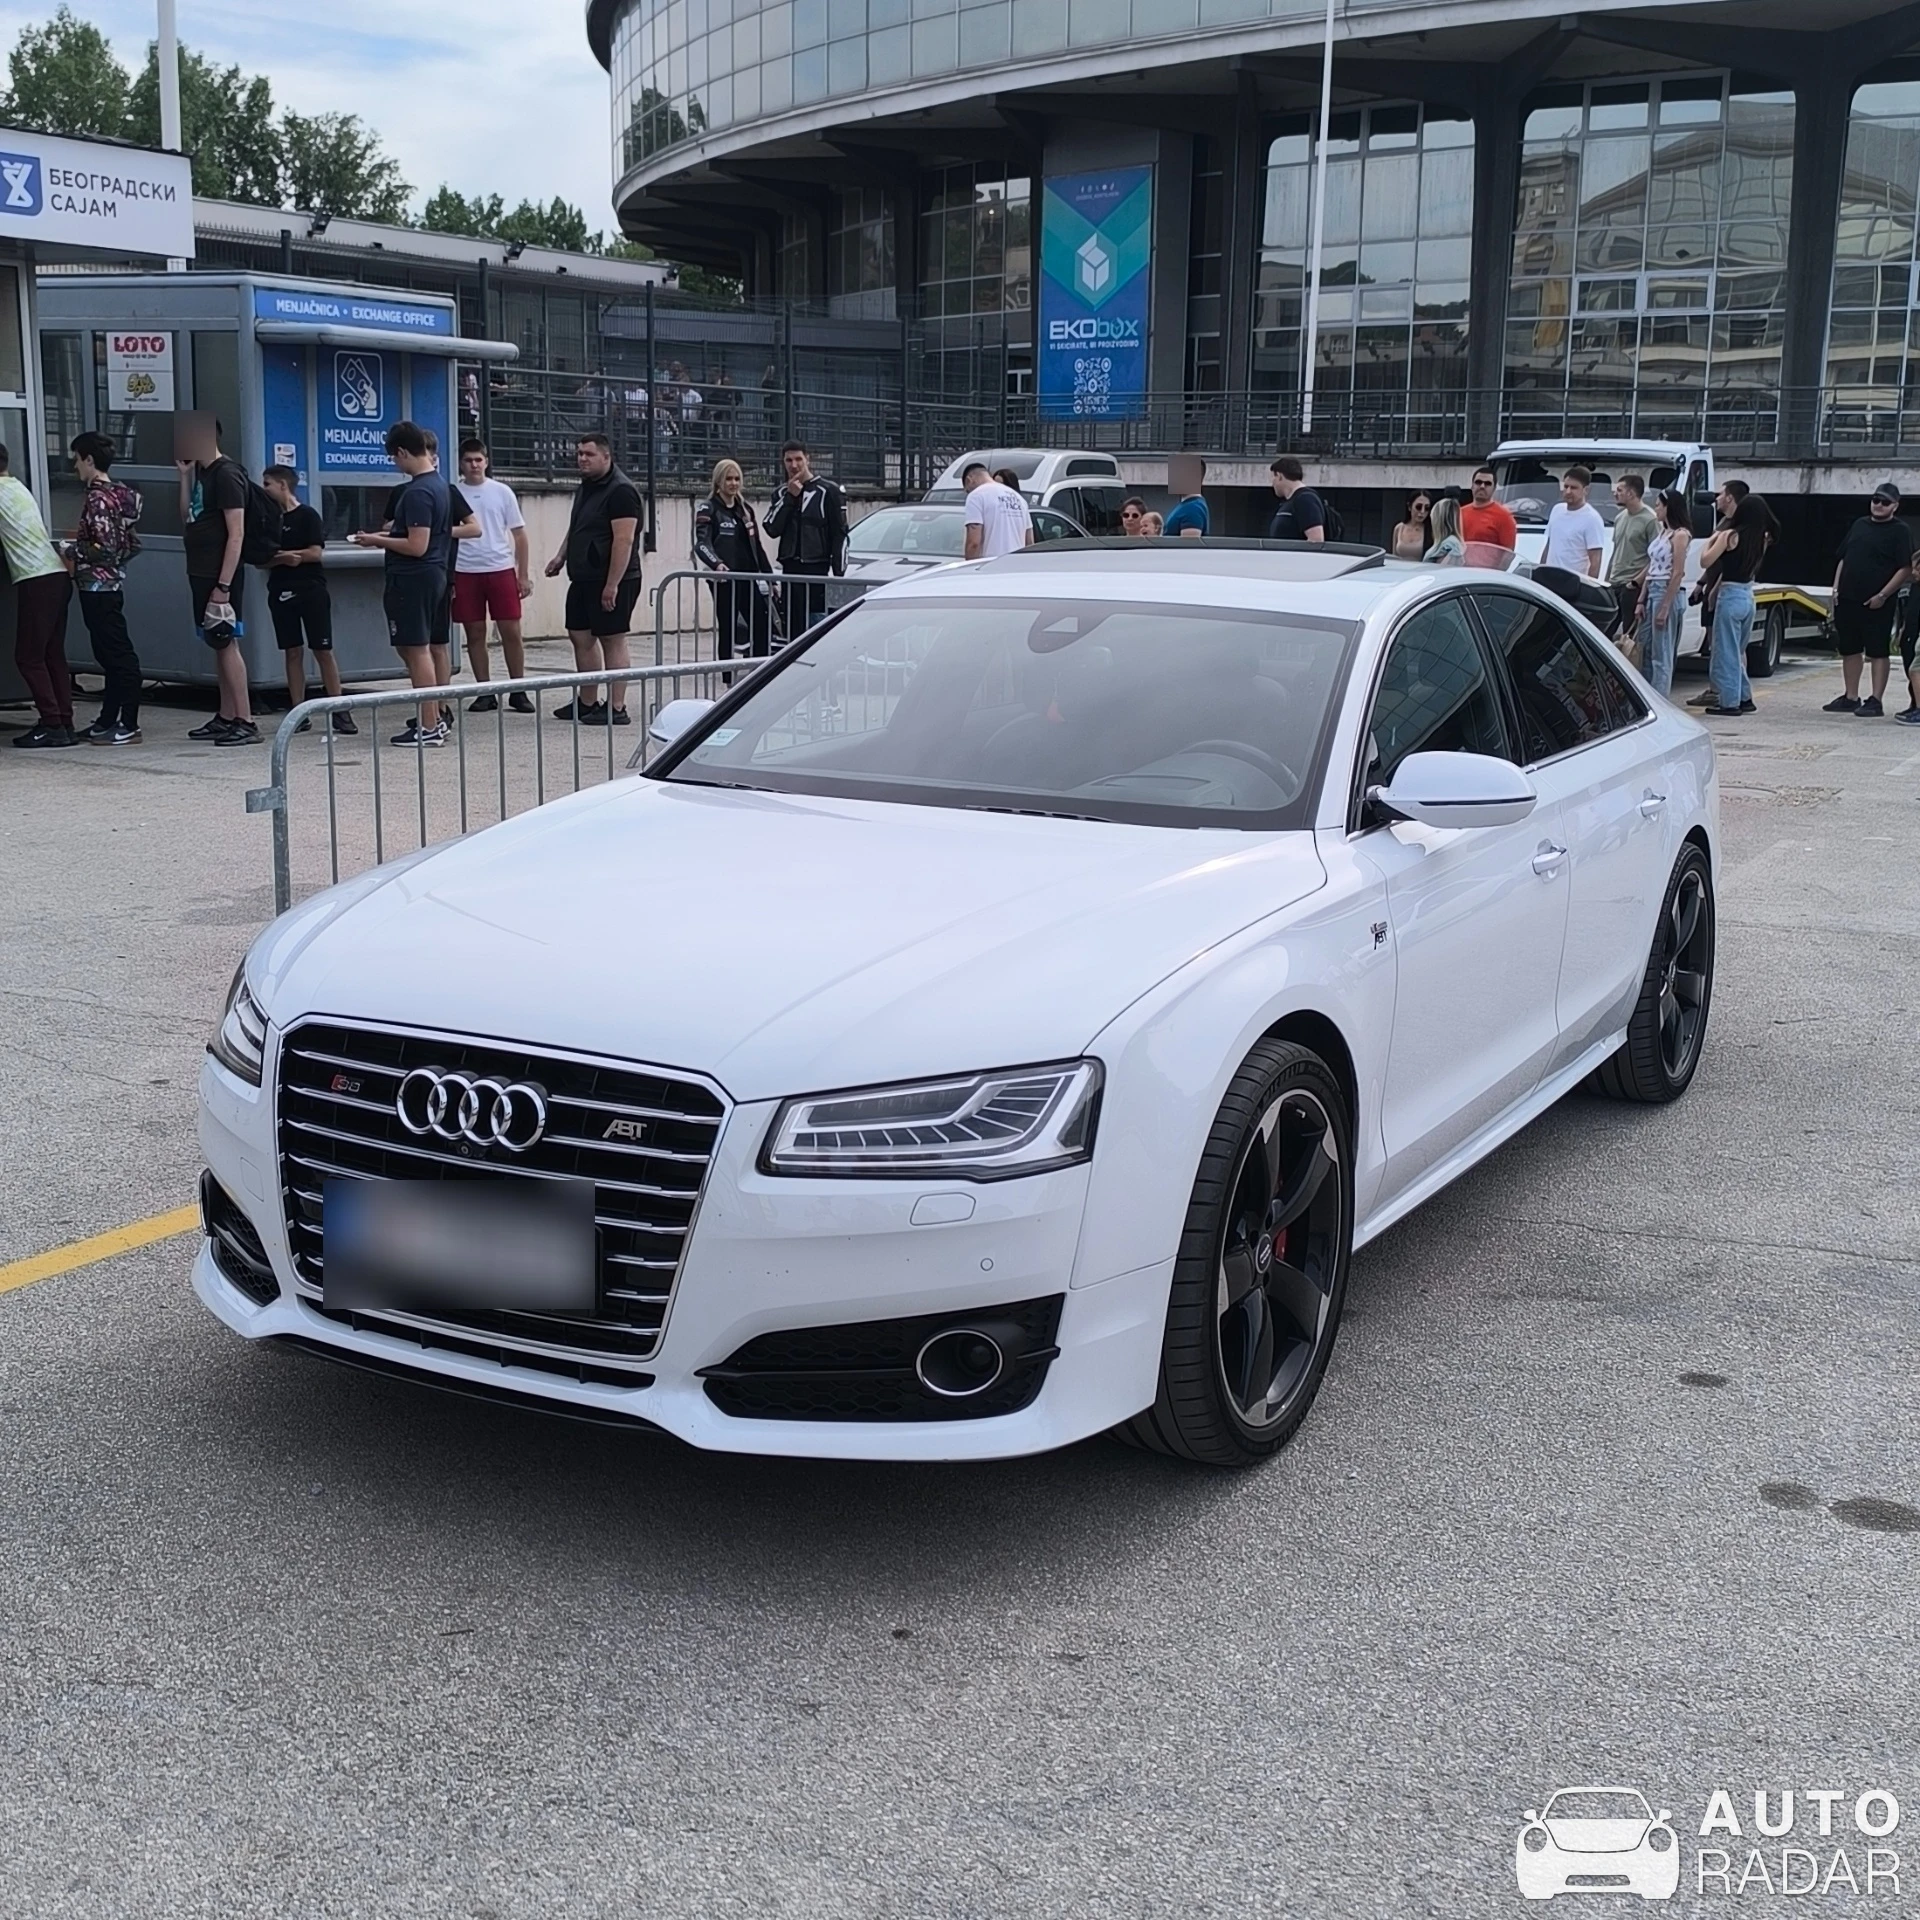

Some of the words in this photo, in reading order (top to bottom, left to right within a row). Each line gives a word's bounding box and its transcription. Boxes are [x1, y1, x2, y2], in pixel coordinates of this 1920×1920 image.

[49, 168, 176, 202] БЕОГРАДСКИ
[51, 194, 117, 218] САЈАМ
[276, 299, 340, 317] MENJAČNICA
[352, 307, 402, 323] EXCHANGE
[403, 312, 435, 326] OFFICE
[114, 336, 165, 353] LOTO
[324, 427, 387, 445] MENJAČNIC
[325, 452, 368, 464] EXCHANGE
[602, 1119, 647, 1140] ABT
